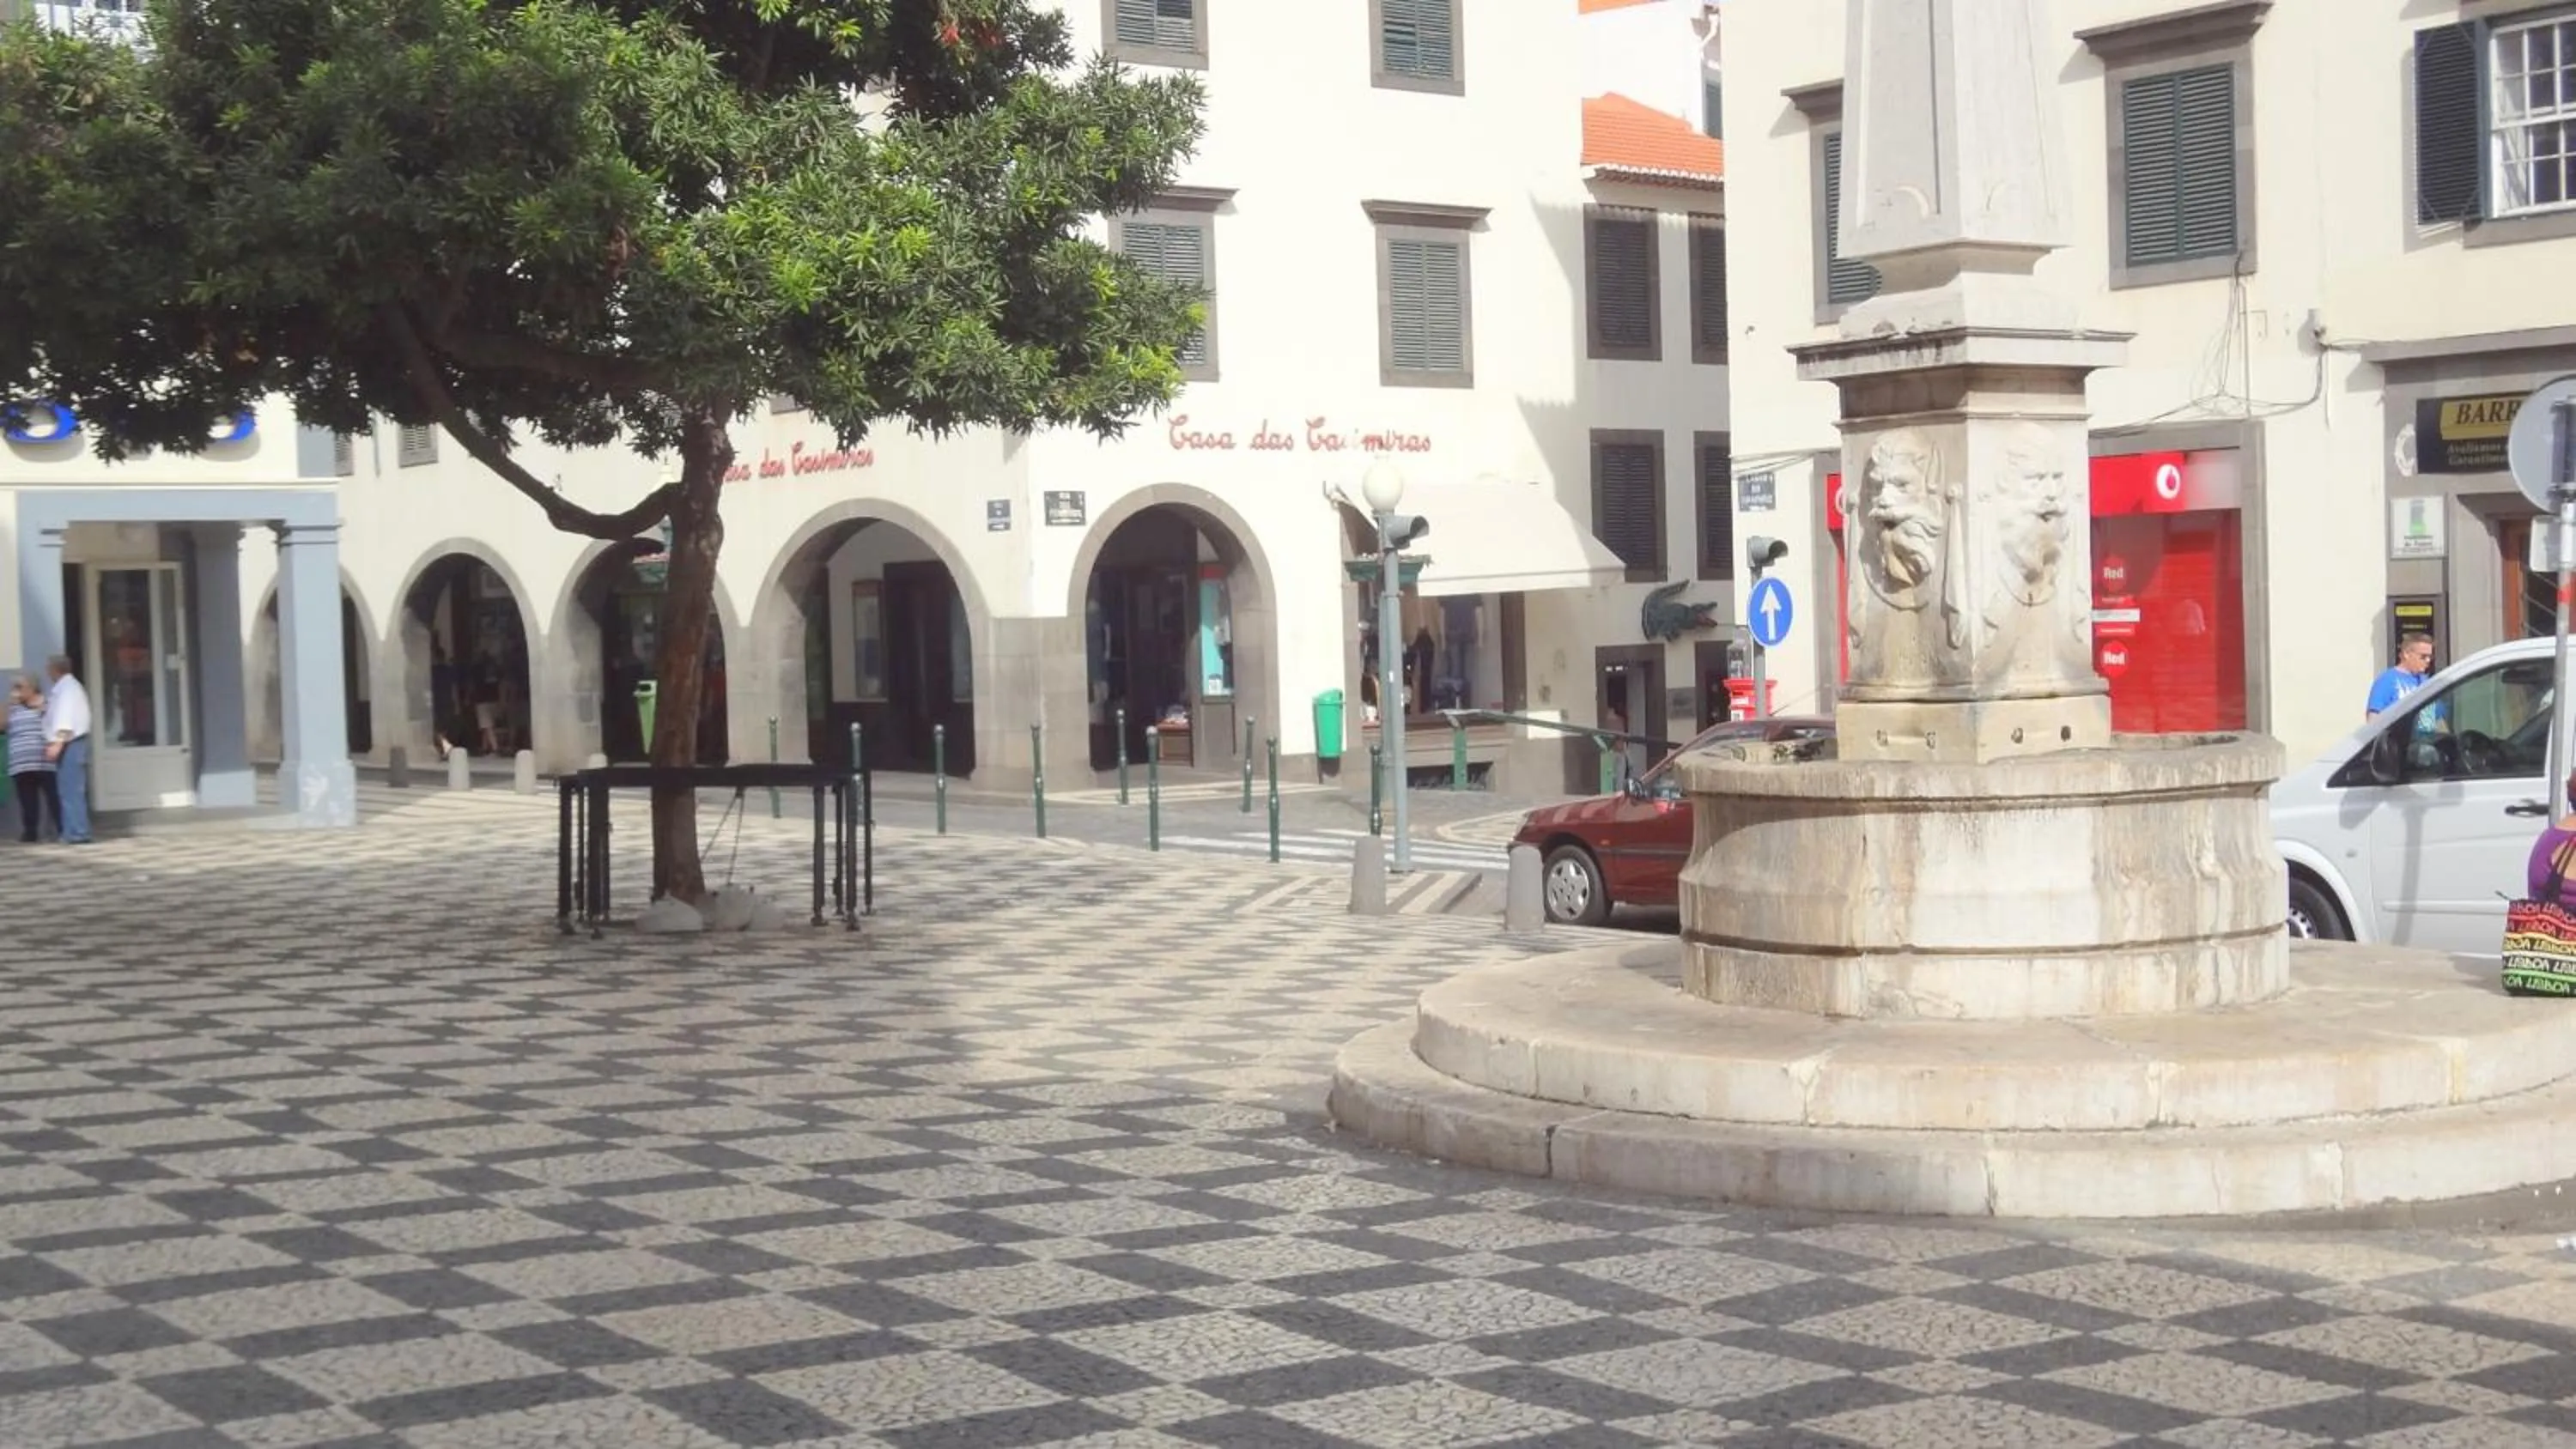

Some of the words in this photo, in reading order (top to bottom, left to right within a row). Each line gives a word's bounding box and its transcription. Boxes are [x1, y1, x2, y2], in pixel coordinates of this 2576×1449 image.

[1168, 414, 1236, 451] Casa
[1249, 418, 1295, 451] das
[1305, 415, 1432, 452] Caimiras
[724, 463, 752, 482] asa
[758, 446, 786, 479] das
[2103, 651, 2125, 665] Red
